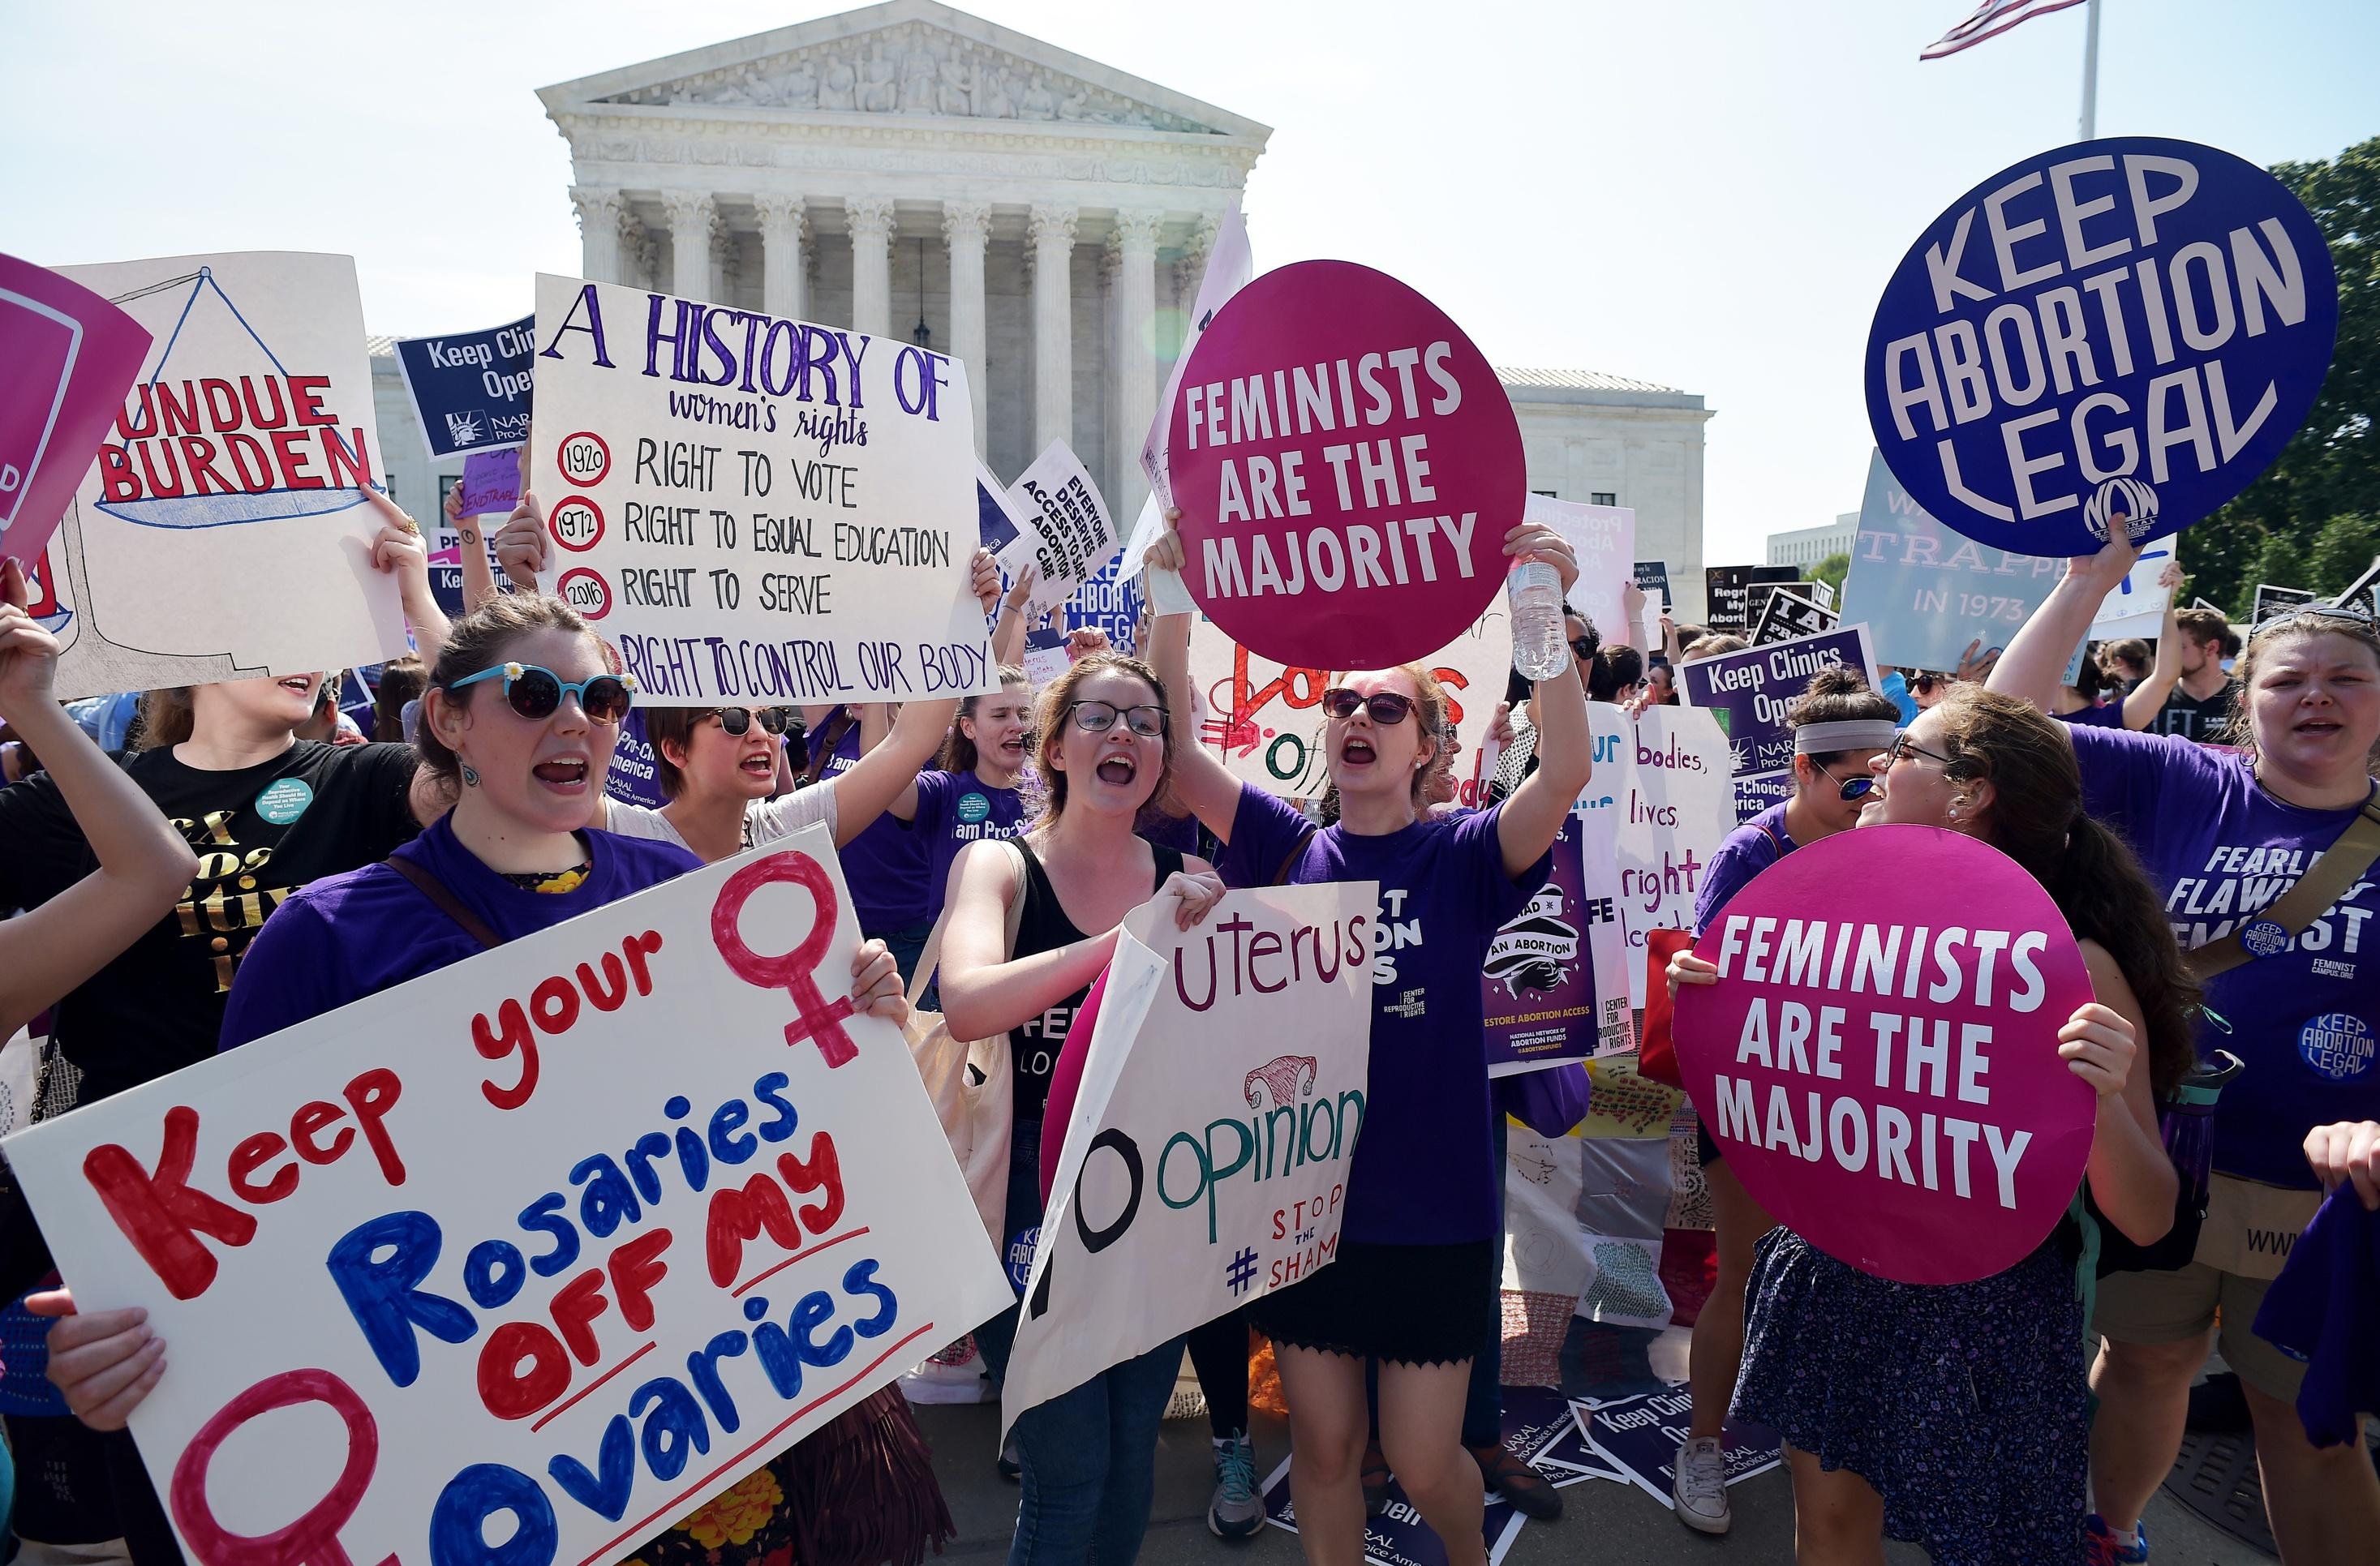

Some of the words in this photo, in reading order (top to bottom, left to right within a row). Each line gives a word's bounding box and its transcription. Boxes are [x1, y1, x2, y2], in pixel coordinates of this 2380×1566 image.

[1925, 154, 2199, 313] KEEP
[1885, 217, 2306, 440] ABORTION
[427, 341, 492, 370] Keep
[496, 325, 535, 359] Clin
[539, 285, 616, 368] A
[642, 294, 870, 408] HISTORY
[893, 345, 949, 421] OF
[118, 375, 339, 440] UNDUE
[1185, 341, 1462, 450] FEMINISTS
[490, 413, 531, 430] NAR
[496, 427, 528, 440] Pro-C
[670, 390, 776, 433] women's
[793, 408, 868, 457] rights
[1938, 359, 2278, 522] LEGAL
[98, 427, 372, 504] BURDEN
[566, 444, 604, 473] 1920
[635, 438, 721, 493] RIGHT
[738, 451, 771, 497] TO
[792, 458, 858, 508] VOTE
[1218, 450, 1311, 524] ARE
[1323, 434, 1437, 511] THE
[1022, 480, 1072, 539] ACCESS
[1068, 475, 1108, 549] EVERYONE
[2084, 478, 2159, 532] NOW
[558, 510, 596, 538] 1972
[625, 502, 699, 547] RIGHT
[710, 511, 736, 549] TO
[754, 513, 822, 558] EQUAL
[835, 523, 949, 567] EDUCATION
[1055, 487, 1096, 558] DESERVES
[1030, 515, 1071, 581] ABORTION
[1068, 536, 1080, 556] TO
[1201, 512, 1478, 599] MAJORITY
[1036, 547, 1055, 581] CARE
[1072, 556, 1087, 584] SAFE
[568, 580, 604, 605] 2016
[621, 568, 696, 608] RIGHT
[709, 570, 740, 610] TO
[759, 574, 831, 615] SERVE
[1635, 575, 1665, 586] RACION
[1714, 588, 1746, 599] Regr
[1709, 613, 1745, 624] Abort
[1727, 600, 1744, 611] My
[1776, 597, 1794, 619] I
[1913, 589, 1948, 613] IN
[1959, 593, 2025, 621] 1973
[620, 634, 701, 697] RIGHT
[857, 639, 913, 691] OUR
[920, 640, 989, 693] BODY
[1707, 663, 1765, 694] Keep
[1769, 644, 1842, 681] Clinics
[1591, 735, 1621, 762] ur
[1635, 724, 1708, 774] bodies,
[1757, 740, 1795, 757] NAR
[1761, 755, 1795, 768] Pro-Ch
[610, 753, 655, 779] merica
[631, 793, 656, 805] America
[1733, 780, 1787, 797] -Choice
[1630, 789, 1679, 829] lives,
[1735, 798, 1765, 811] erica
[169, 810, 240, 846] ex
[956, 824, 980, 839] am
[2204, 846, 2326, 874] FEARL
[1622, 849, 1701, 913] right
[2245, 929, 2286, 947] ABORTION
[2255, 923, 2282, 935] KEEP
[1491, 941, 1509, 956] AN
[1514, 939, 1570, 955] ABORTION
[2247, 940, 2279, 955] LEGAL
[1716, 915, 2048, 1013] FEMINISTS
[2312, 967, 2354, 980] CAMPUS.ORG
[2313, 959, 2356, 972] FEMINIST
[1384, 1001, 1425, 1013] REPRODUCTIVE
[1403, 988, 1425, 998] CENTER
[1605, 996, 1628, 1012] CENTER
[1404, 1008, 1425, 1019] RIGHTS
[1484, 1015, 1515, 1028] ESTORE
[1518, 1010, 1562, 1023] ABORTION
[1562, 1006, 1590, 1017] ACCESS
[1606, 1011, 1619, 1023] FOR
[2318, 1014, 2366, 1035] KEEP
[1510, 1031, 1535, 1040] NATIONAL
[1536, 1028, 1559, 1037] NETWORK
[1510, 1037, 1545, 1048] ABORTION
[1546, 1034, 1566, 1043] FUNDS
[1598, 1021, 1630, 1038] RODUCTIVE
[1609, 1033, 1632, 1049] RIGHTS
[2301, 1028, 2374, 1058] ABORTION
[1736, 996, 1846, 1080] ARE
[1870, 1010, 1992, 1105] THE
[2308, 1048, 2366, 1074] LEGAL
[83, 1067, 406, 1299] Keep
[471, 929, 663, 1109] your
[1715, 1073, 2033, 1210] MAJORITY
[1158, 1089, 1367, 1245] opinion
[1272, 1184, 1343, 1240] STOP
[325, 1071, 798, 1388] Rosaries
[1295, 1226, 1315, 1245] THE
[1269, 1232, 1337, 1288] SHAM
[477, 1227, 672, 1421] OFF
[428, 1258, 897, 1566] Ovaries
[1594, 1405, 1661, 1434] Keep
[1647, 1388, 1692, 1417] Clin
[1724, 1445, 1759, 1463] RAL
[1724, 1454, 1762, 1476] ro-Choice
[1543, 1467, 1580, 1482] Pro-C
